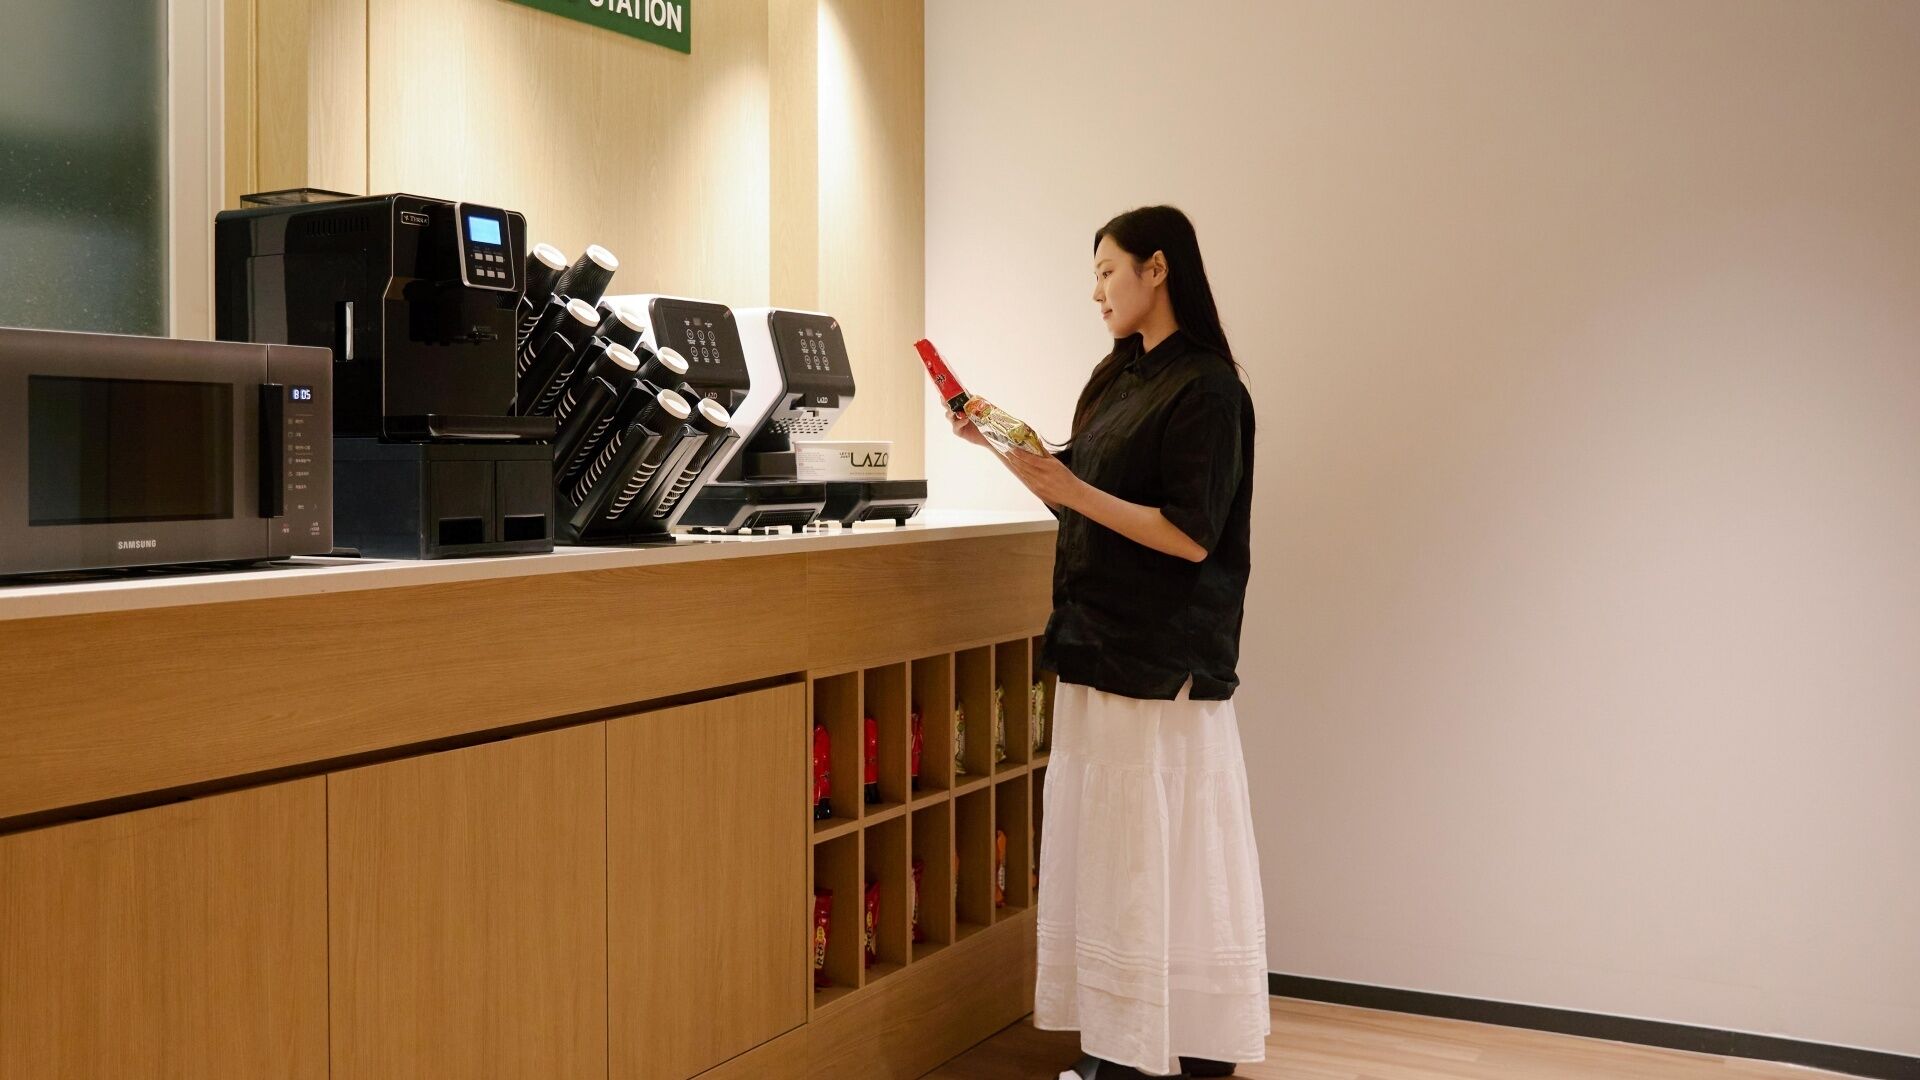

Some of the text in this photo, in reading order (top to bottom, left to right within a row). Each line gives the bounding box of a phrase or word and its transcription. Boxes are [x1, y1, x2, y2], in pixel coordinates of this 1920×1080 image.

[589, 0, 682, 33] ATION
[851, 452, 888, 467] LAZO
[118, 539, 157, 550] SAMSUNG
